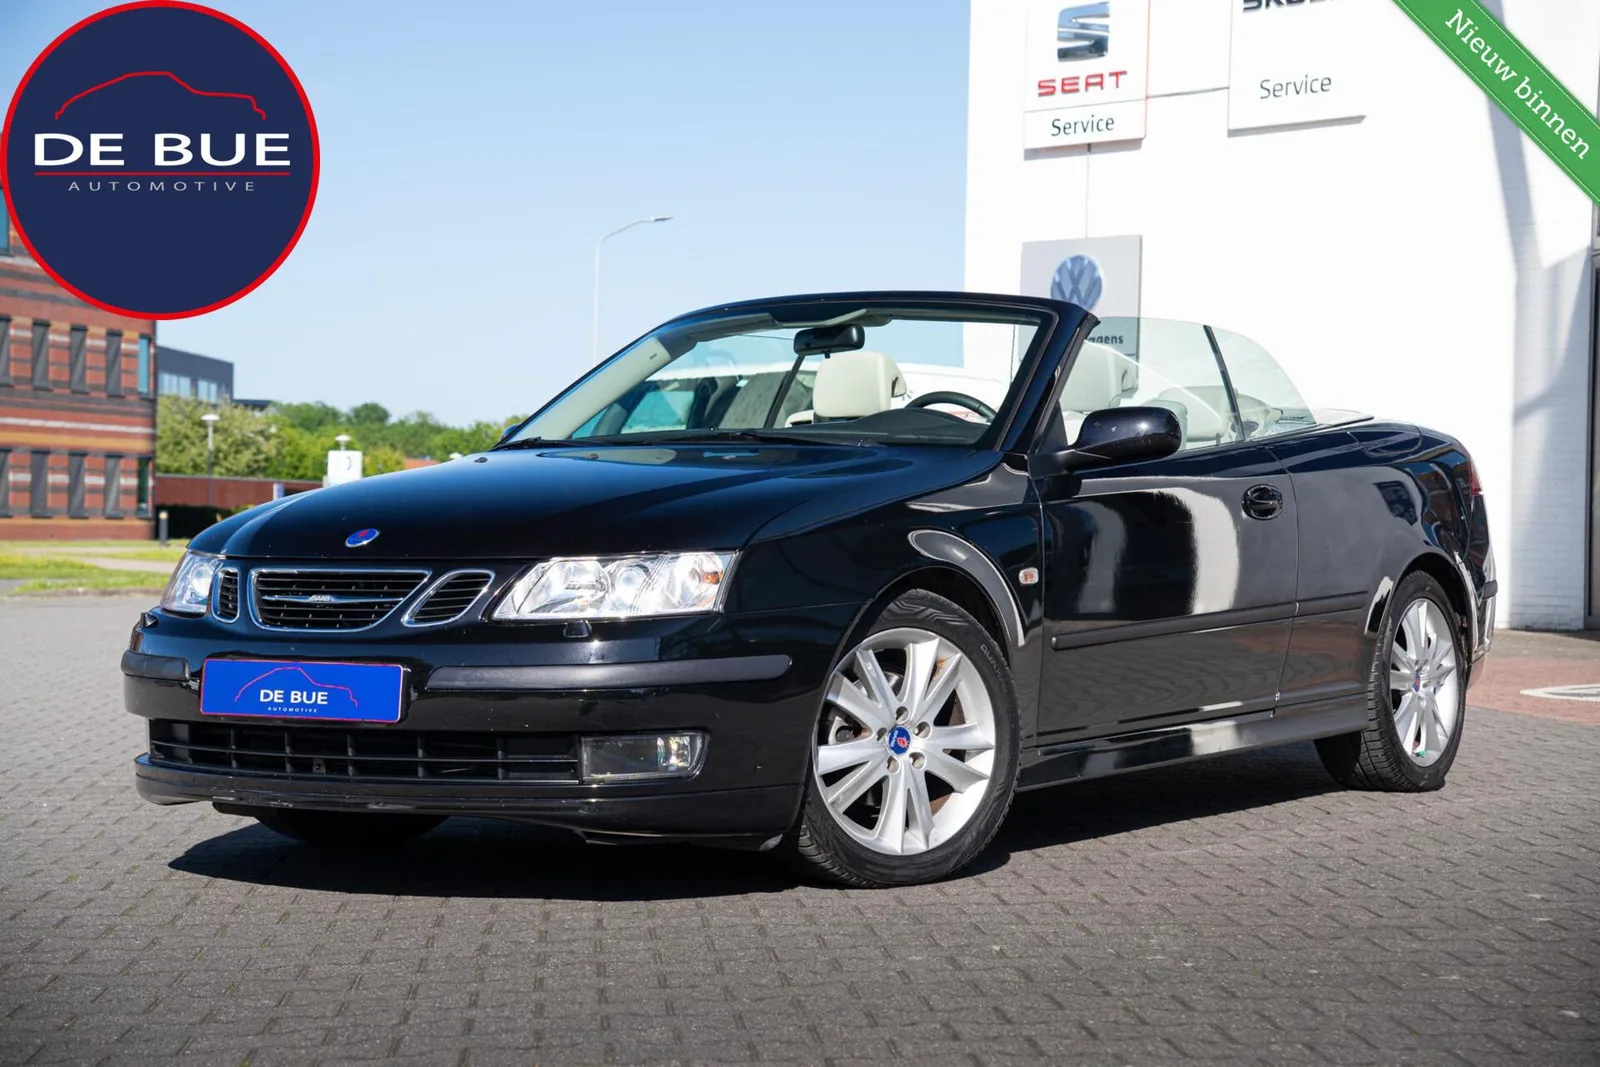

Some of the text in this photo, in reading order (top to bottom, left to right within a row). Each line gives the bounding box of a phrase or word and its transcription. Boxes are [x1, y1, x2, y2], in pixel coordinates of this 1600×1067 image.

[1037, 70, 1128, 97] SEAT
[1260, 74, 1332, 99] Service
[1050, 114, 1115, 136] Service
[259, 689, 328, 704] DE BUE
